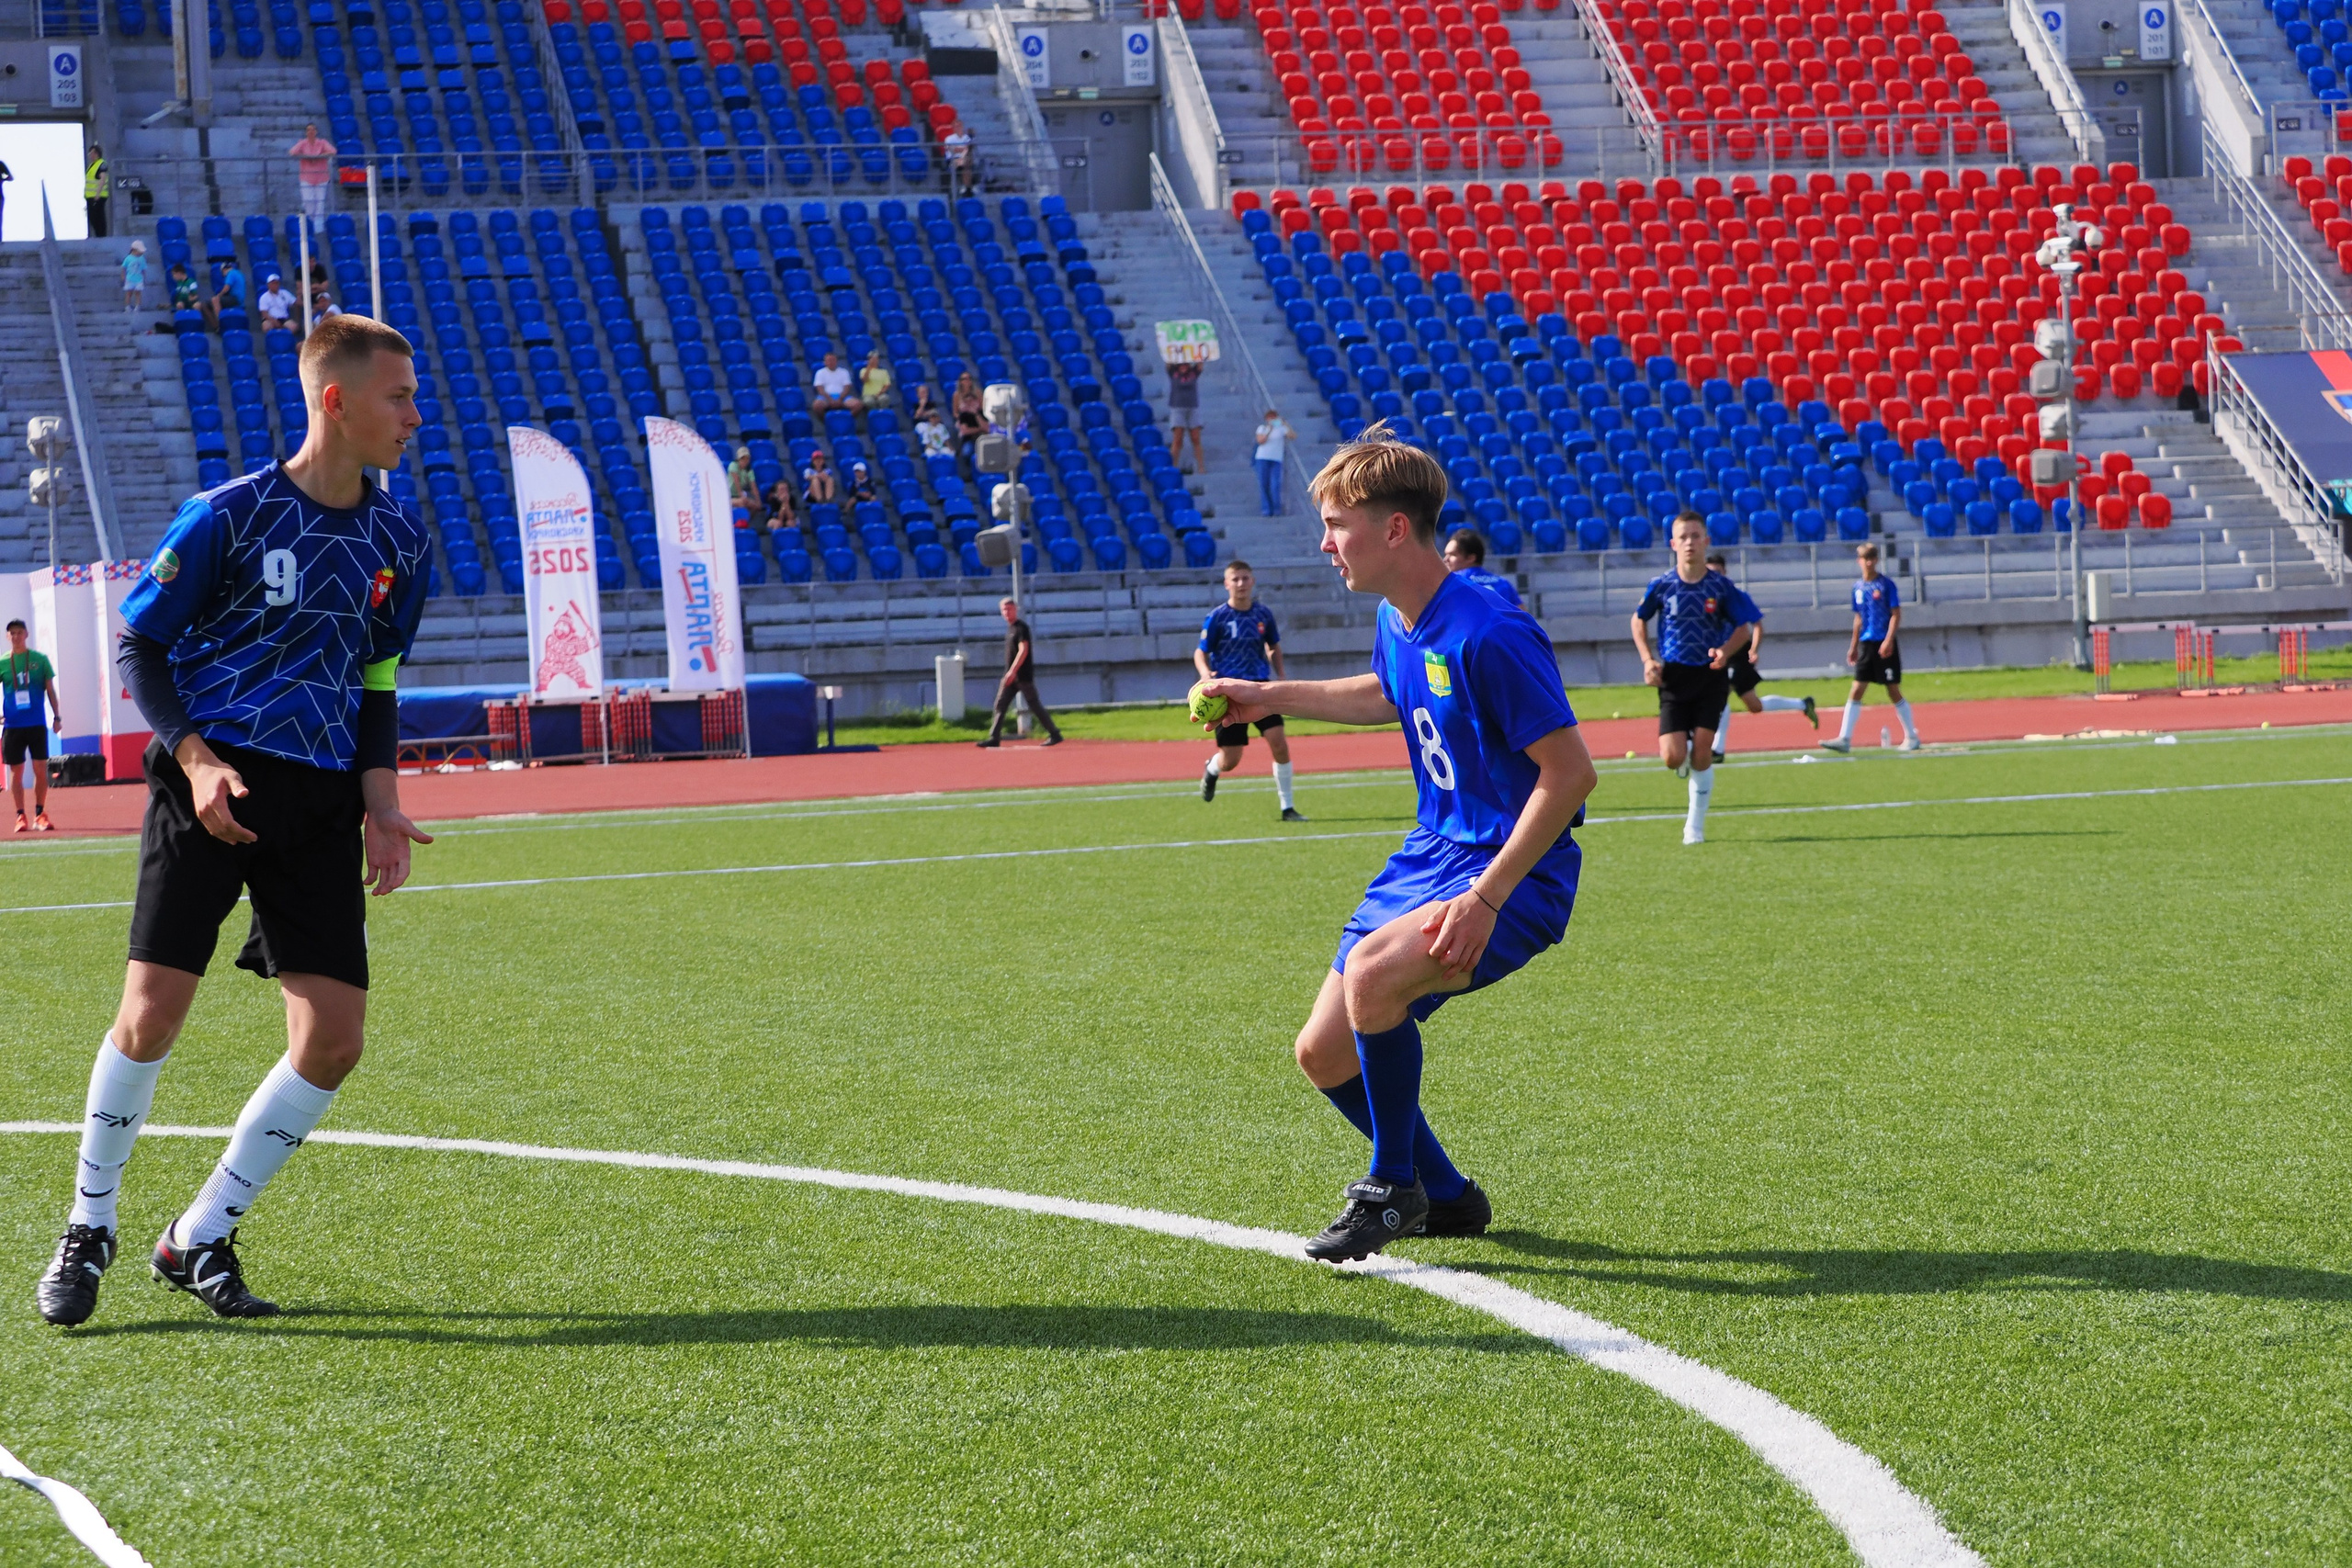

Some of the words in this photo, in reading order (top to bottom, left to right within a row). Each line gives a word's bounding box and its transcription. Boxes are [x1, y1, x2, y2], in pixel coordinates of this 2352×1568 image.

[2149, 11, 2160, 26] A
[2147, 33, 2164, 43] 201
[2147, 46, 2164, 55] 101
[60, 56, 73, 72] A
[57, 79, 77, 89] 205
[58, 93, 77, 103] 103
[264, 548, 297, 606] 9
[1667, 594, 1678, 615] 1
[1227, 621, 1238, 638] 1
[1413, 707, 1455, 791] 8
